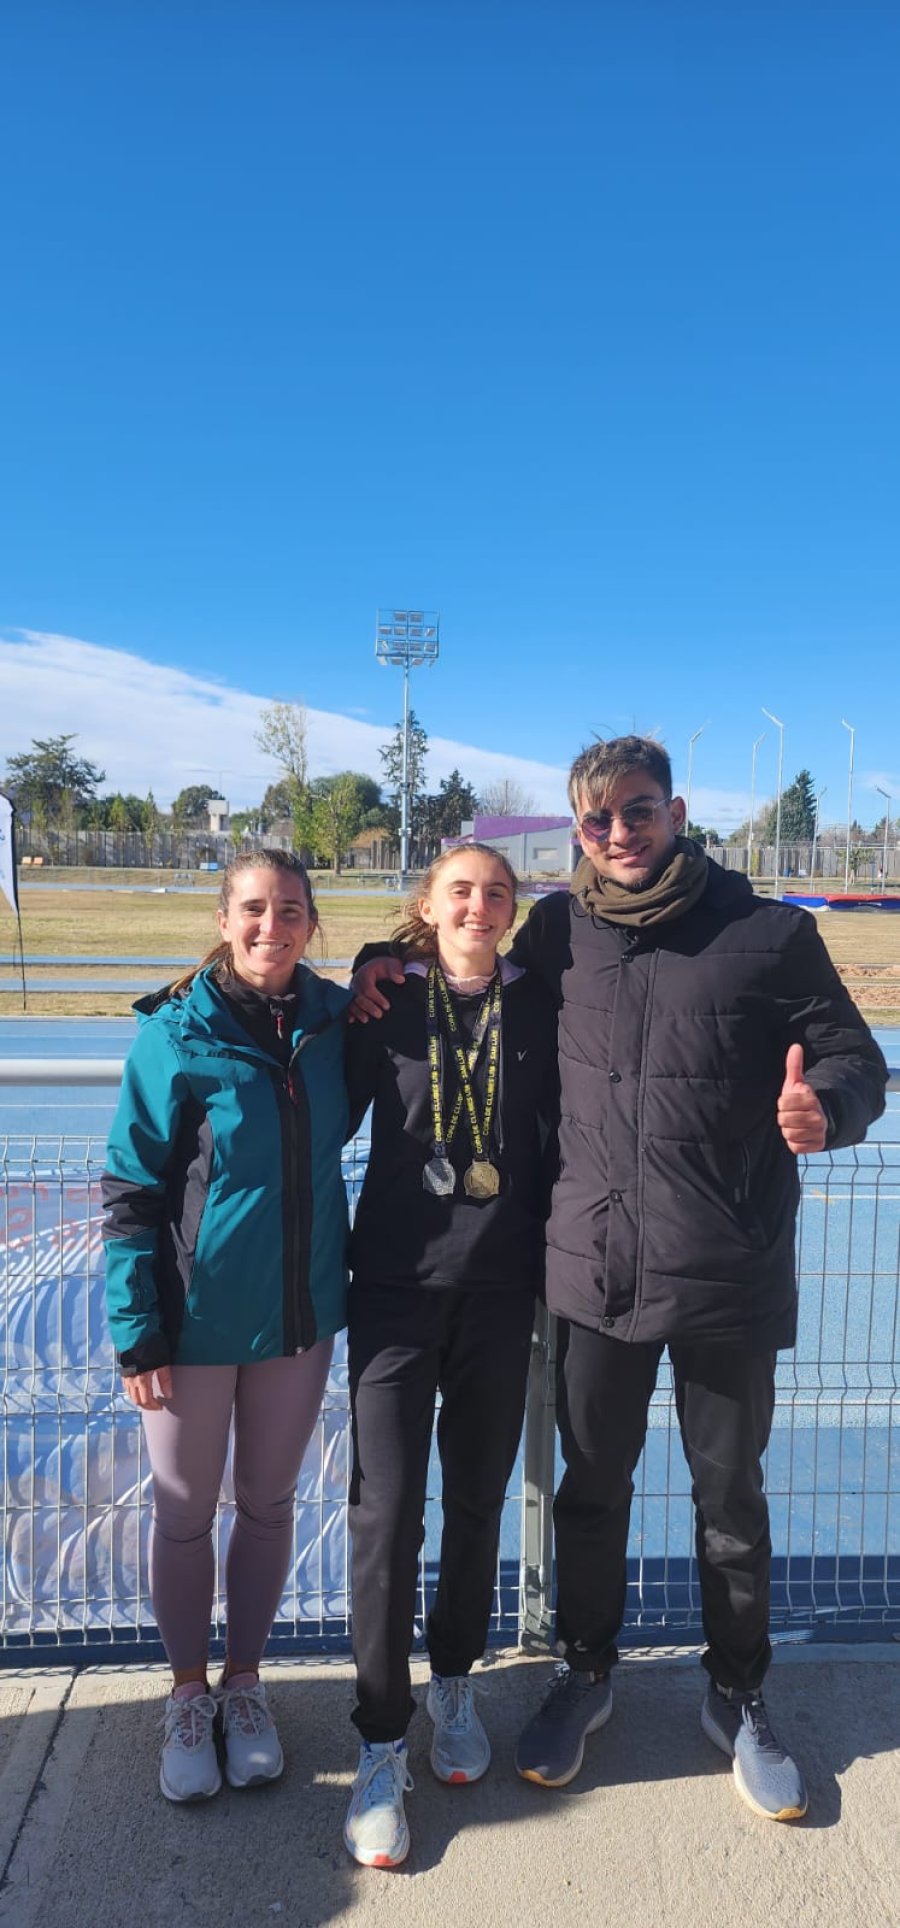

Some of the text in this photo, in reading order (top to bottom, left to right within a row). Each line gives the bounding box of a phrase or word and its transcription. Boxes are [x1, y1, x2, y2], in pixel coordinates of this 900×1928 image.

[484, 1106, 492, 1117] DE
[434, 1112, 441, 1123] DE
[472, 1124, 480, 1135] DE
[482, 1117, 490, 1136] COPA
[474, 1134, 483, 1154] COPA
